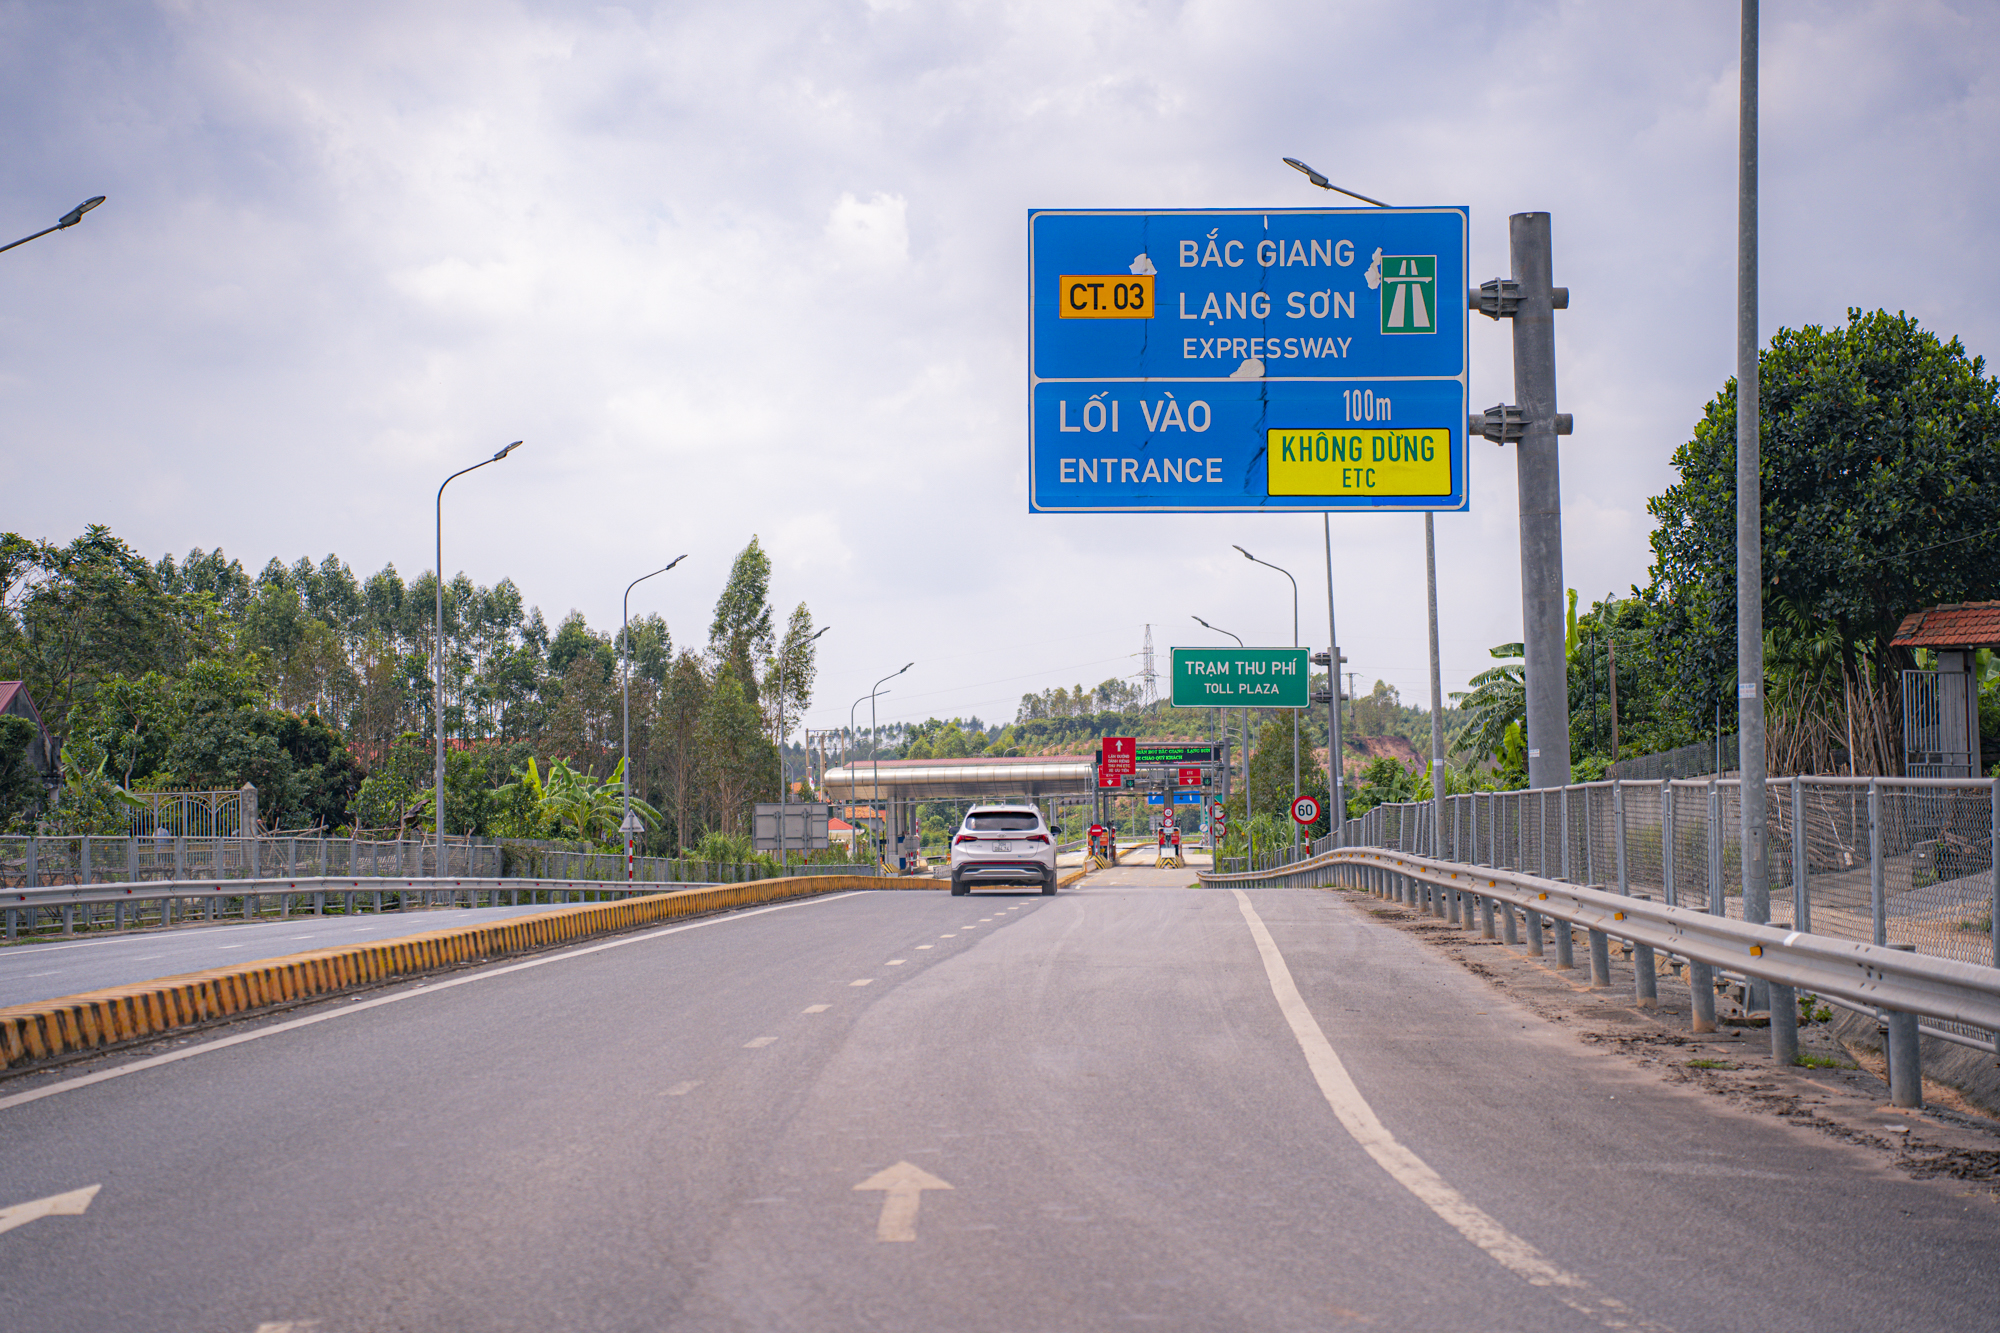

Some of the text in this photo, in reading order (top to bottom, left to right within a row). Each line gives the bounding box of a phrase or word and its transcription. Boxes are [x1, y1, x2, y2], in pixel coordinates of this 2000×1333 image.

[1180, 228, 1355, 268] BẮC GIANG
[1069, 283, 1145, 310] CT. 03
[1179, 288, 1355, 326] LẠNG SƠN
[1183, 337, 1353, 359] EXPRESSWAY
[1059, 391, 1212, 433] LỐI VÀO
[1343, 388, 1392, 422] 100m
[1282, 431, 1435, 463] KHÔNG DỪNG
[1059, 457, 1223, 483] ENTRANCE
[1342, 468, 1376, 488] ETC
[1185, 657, 1297, 677] TRẠM THU PHÍ
[1204, 683, 1280, 695] TOLL PLAZA
[1297, 803, 1314, 817] 60
